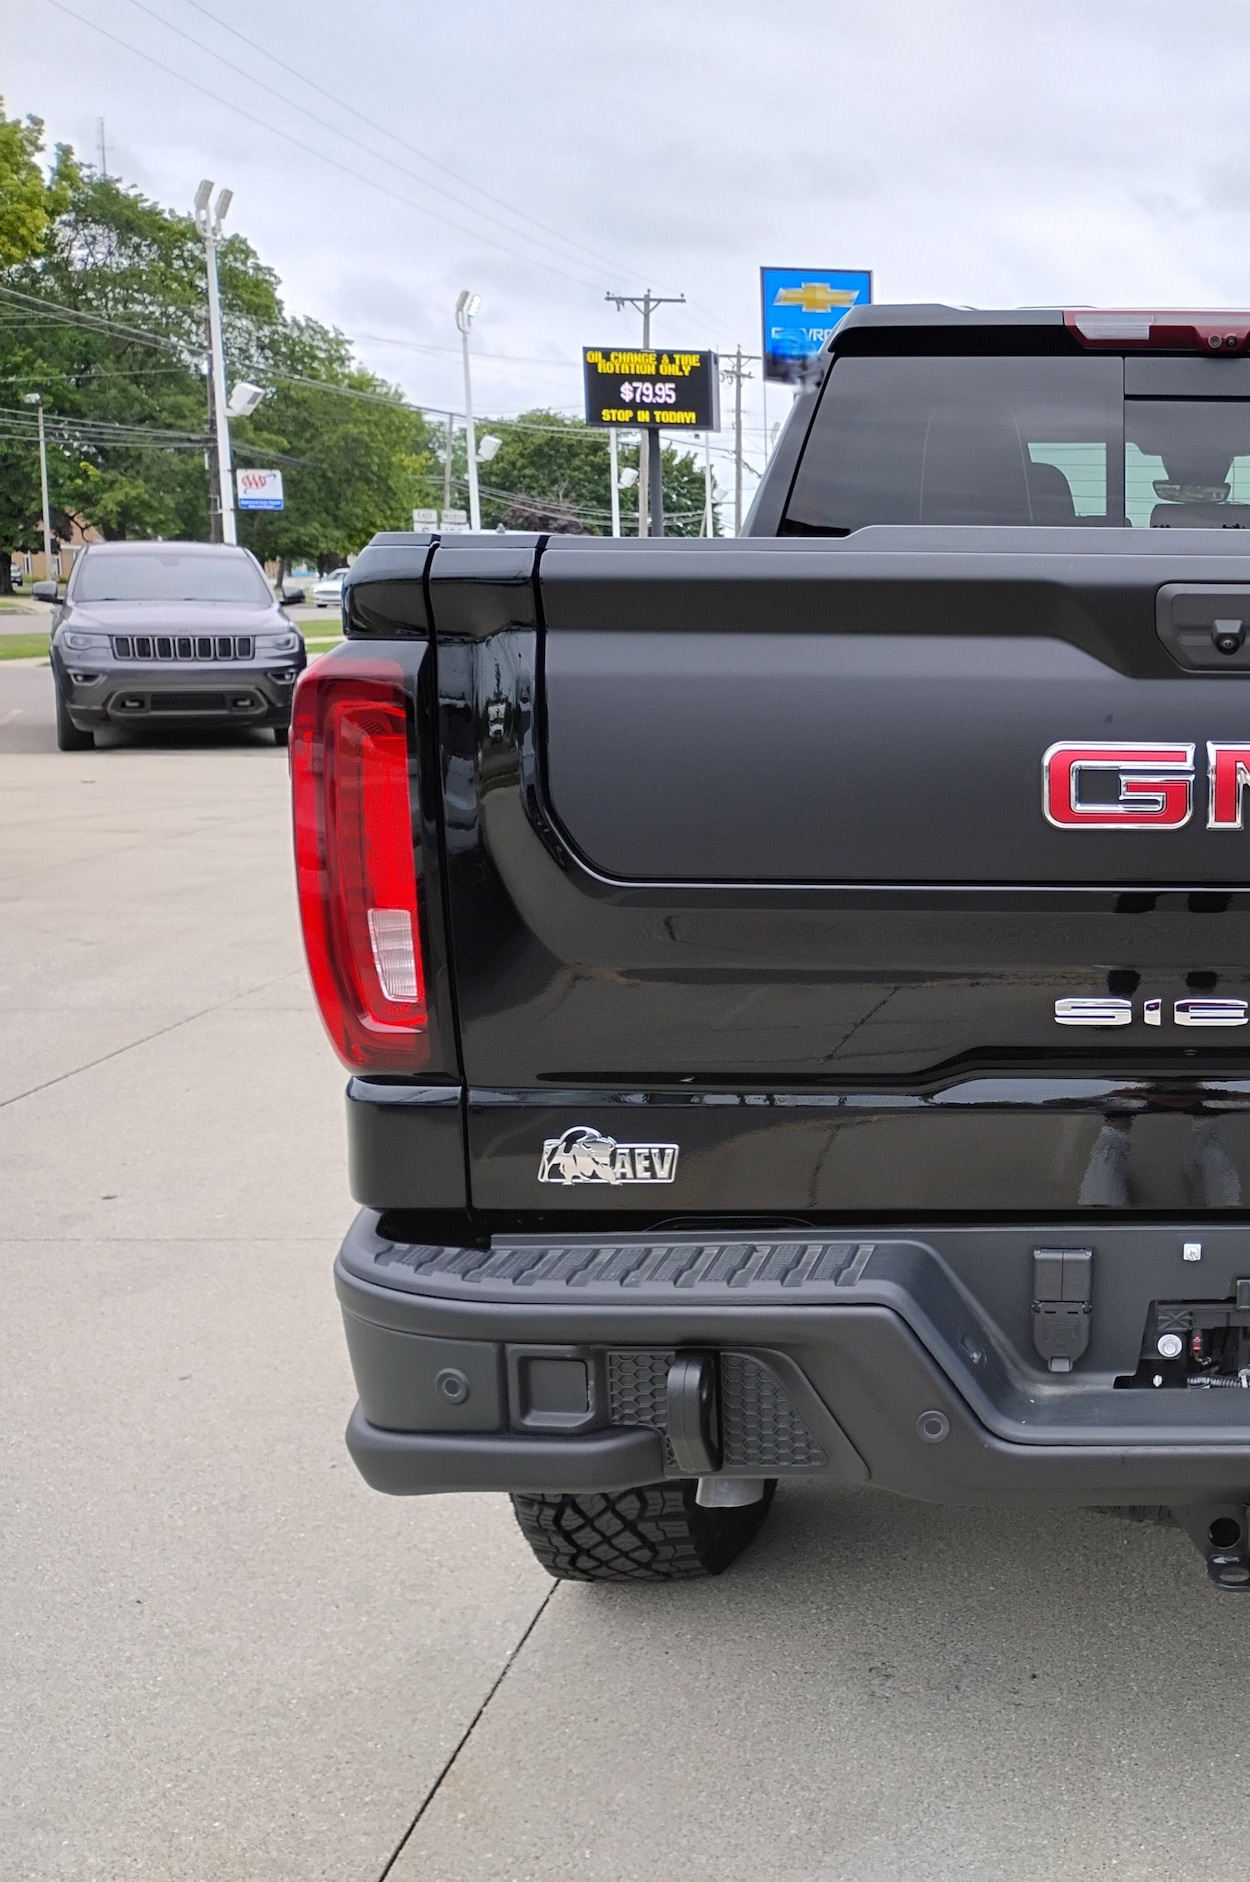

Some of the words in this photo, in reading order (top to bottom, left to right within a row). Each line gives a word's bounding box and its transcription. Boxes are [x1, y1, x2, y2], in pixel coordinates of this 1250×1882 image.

[586, 351, 606, 364] OIL
[610, 351, 657, 365] CHANGE
[661, 353, 669, 365] &
[673, 354, 700, 367] TIRE
[597, 362, 656, 375] ROTATION
[659, 364, 691, 376] ONLY
[620, 381, 676, 404] $79.95
[601, 409, 634, 422] STOP
[637, 410, 650, 422] IN
[653, 411, 696, 424] TODAY!
[614, 1147, 675, 1180] AEV
